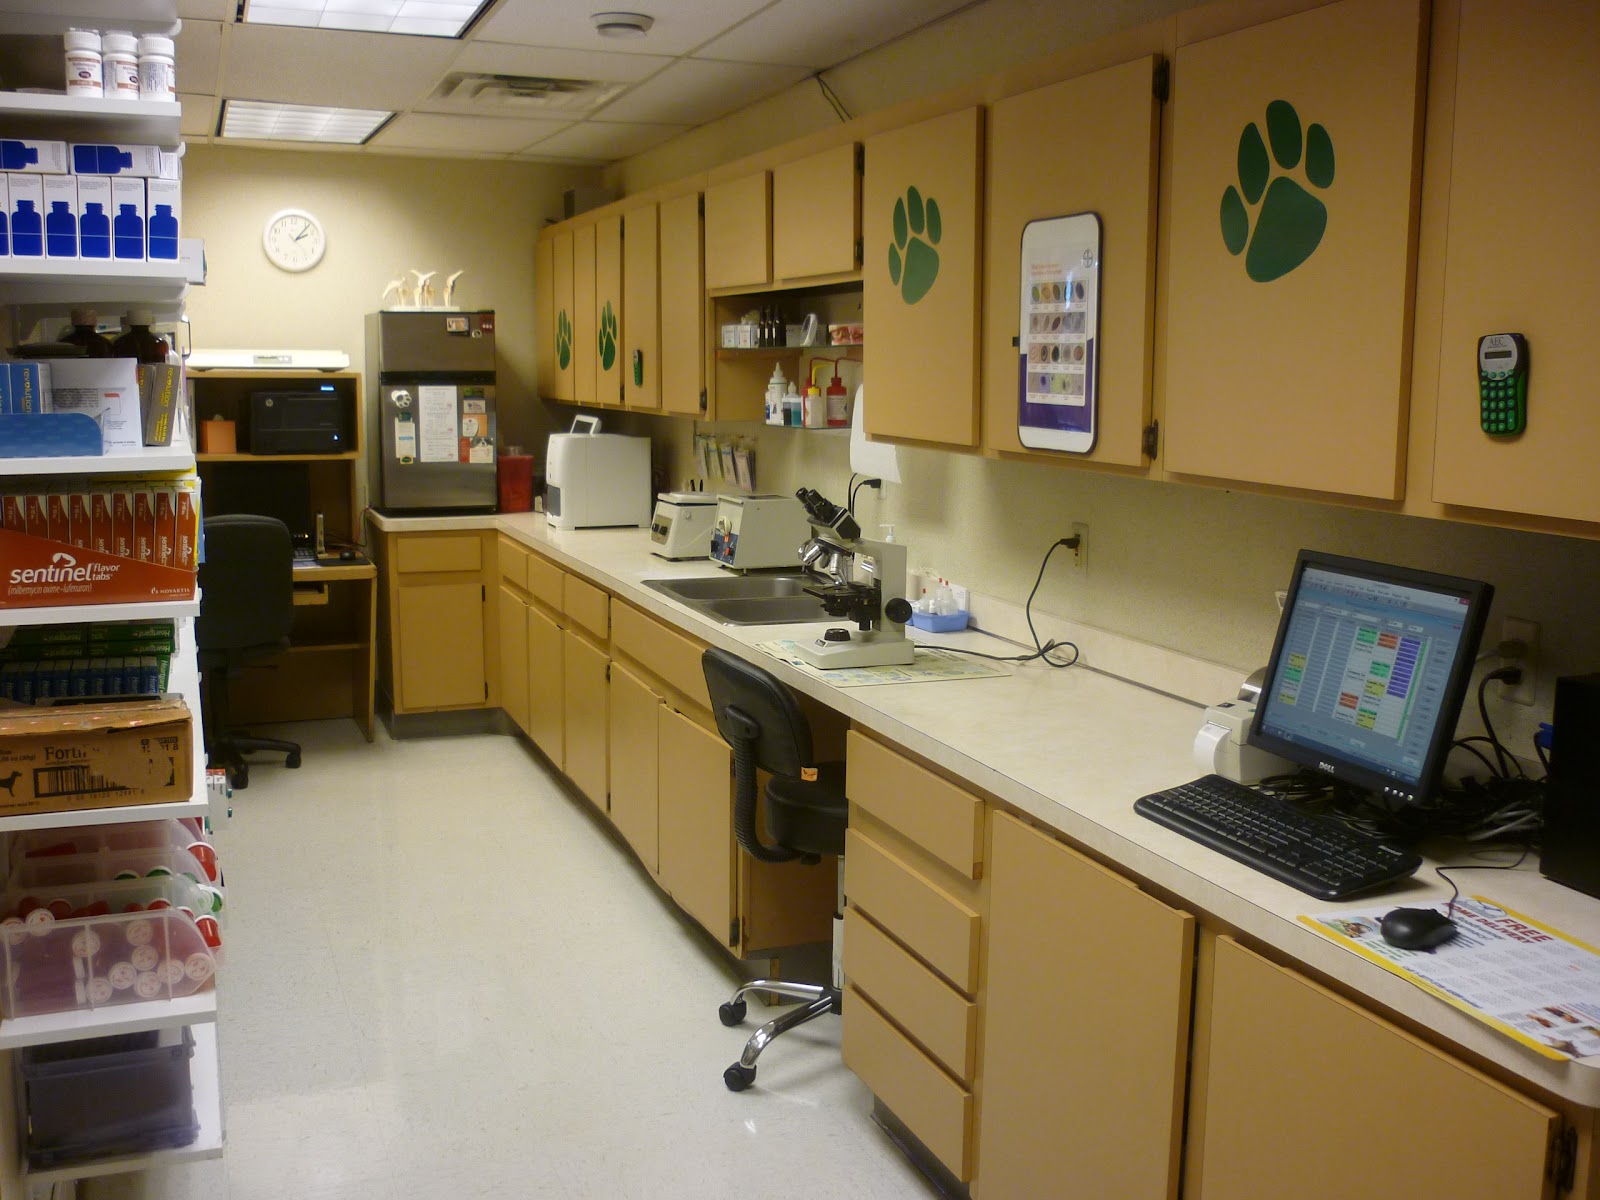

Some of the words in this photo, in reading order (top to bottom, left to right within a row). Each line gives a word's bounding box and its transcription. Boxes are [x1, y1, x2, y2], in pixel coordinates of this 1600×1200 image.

[24, 368, 33, 413] revolution
[164, 367, 174, 408] revolution
[9, 563, 92, 584] sentinel
[93, 563, 120, 572] flavor
[158, 660, 168, 690] Heartgard
[1319, 761, 1334, 774] DELL
[1476, 918, 1535, 944] DELIVERY
[1495, 918, 1554, 942] FREE
